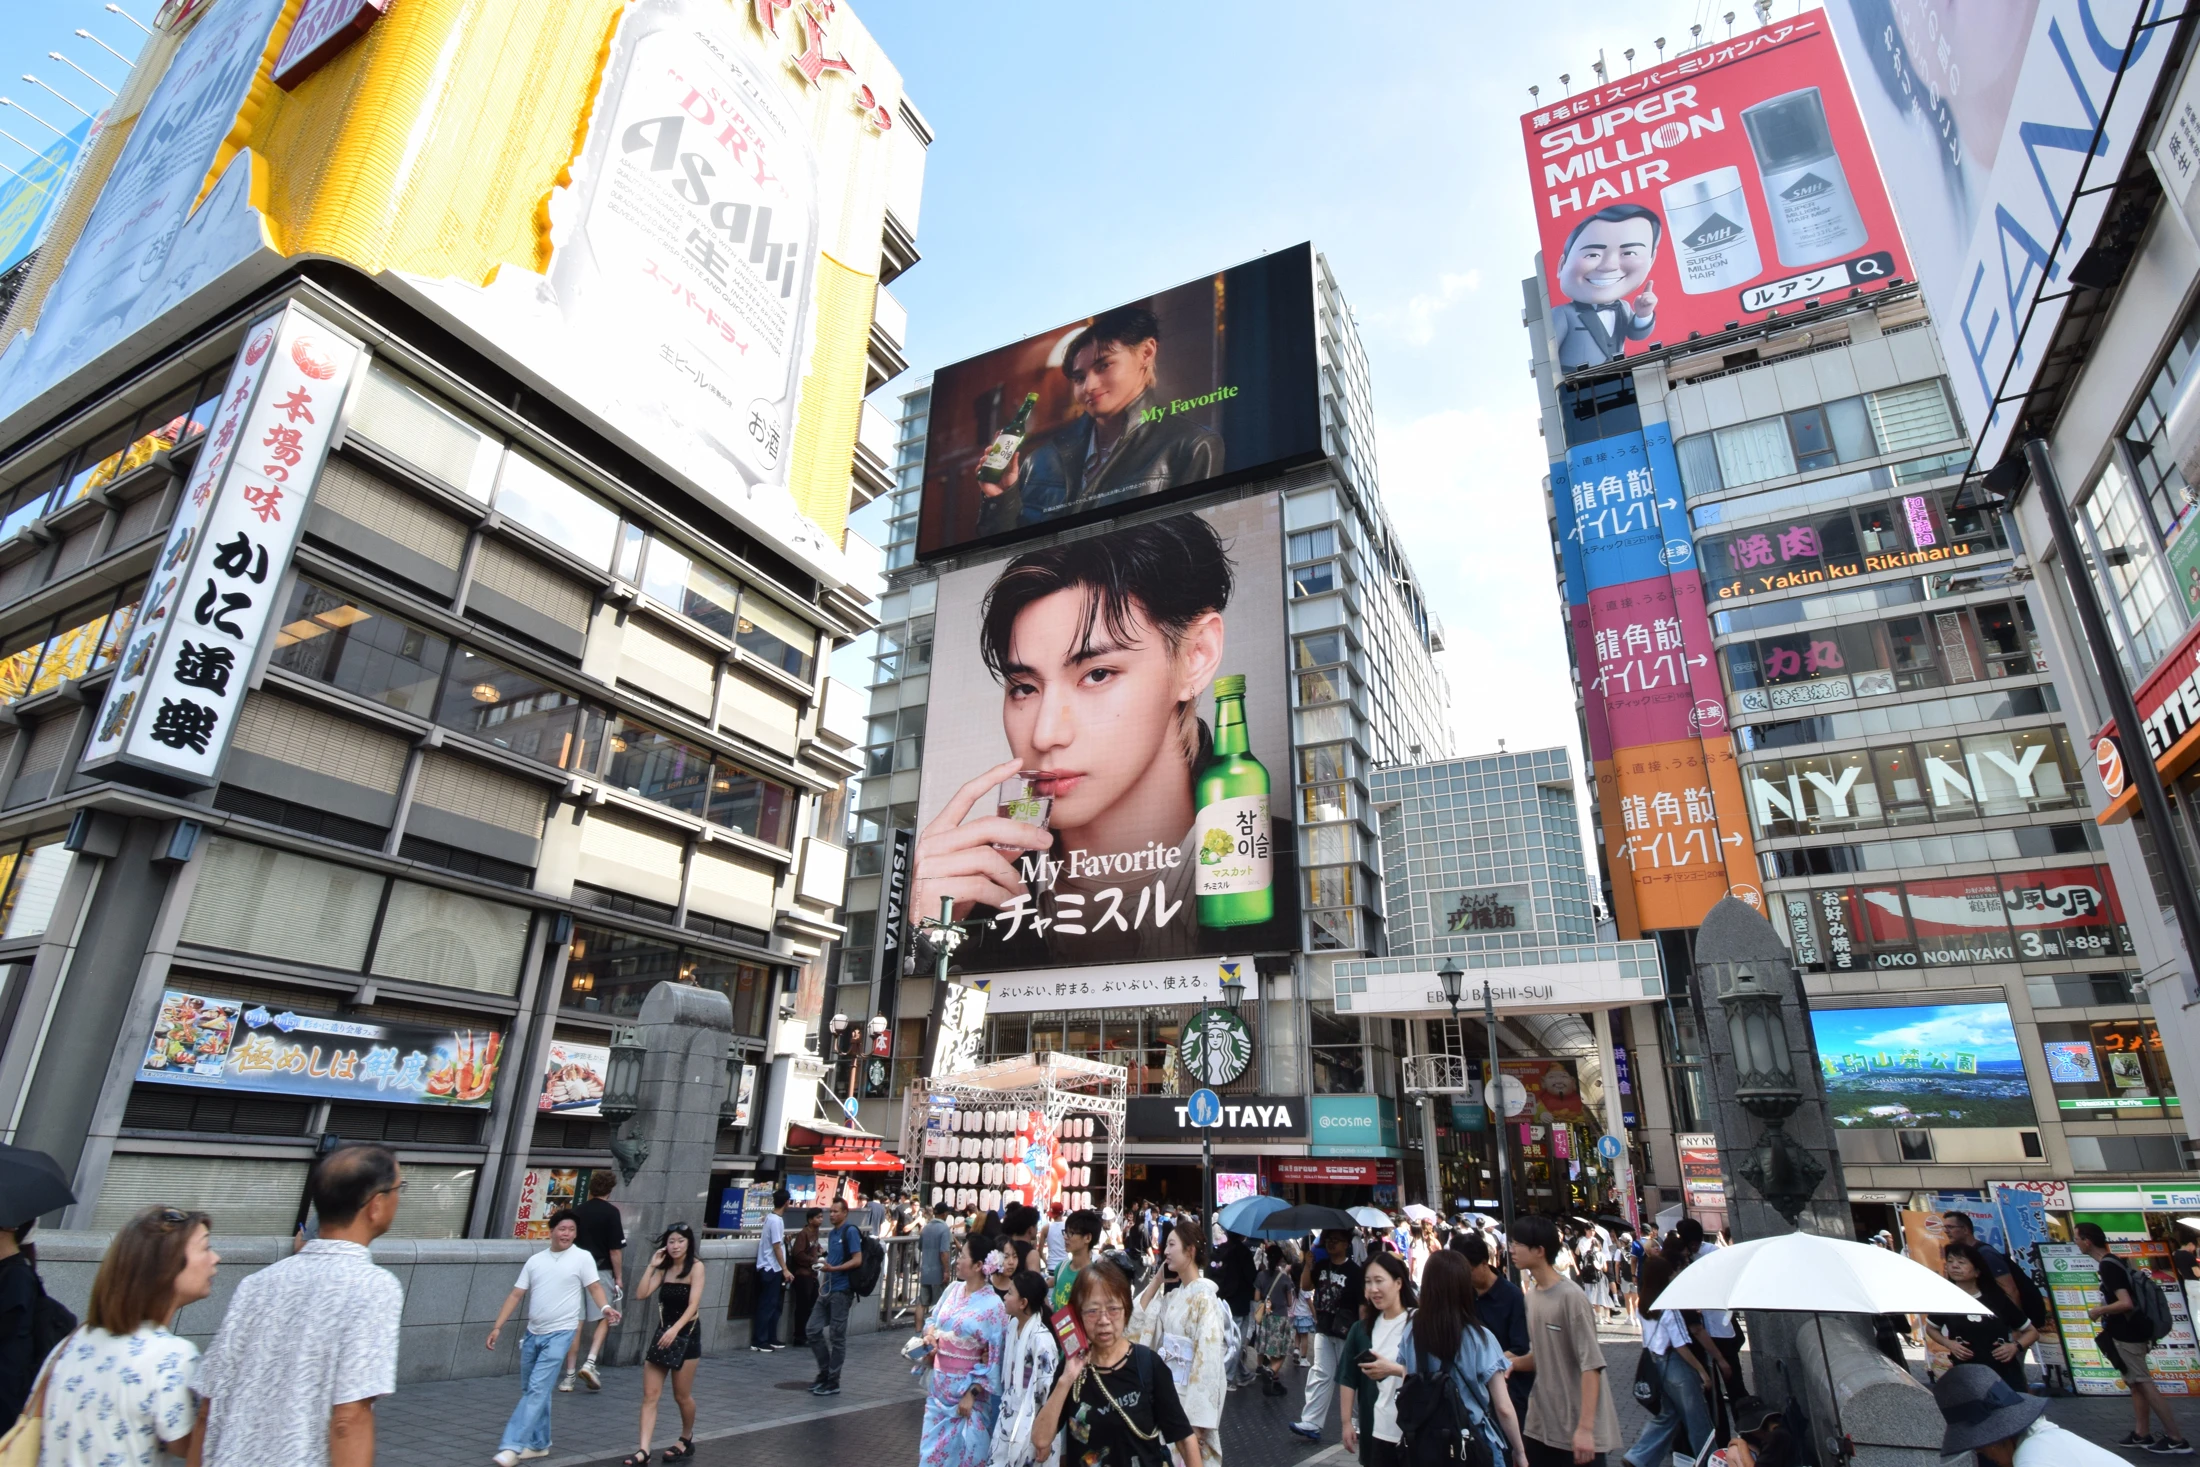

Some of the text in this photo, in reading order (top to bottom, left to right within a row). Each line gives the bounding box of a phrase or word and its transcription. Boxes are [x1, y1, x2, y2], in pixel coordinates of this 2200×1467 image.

[707, 87, 766, 154] SUPER
[1540, 84, 1700, 160] SUPER
[1543, 107, 1726, 188] MILLION
[1549, 159, 1671, 219] HAIR
[1792, 182, 1824, 198] SMH
[621, 115, 799, 299] Asahi
[1784, 202, 1816, 214] SUPER
[1786, 206, 1821, 219] MILLION
[1787, 214, 1809, 224] HAIR
[1696, 226, 1734, 247] SMH
[684, 228, 730, 288] 生
[1686, 252, 1724, 267] SUPER
[1687, 258, 1729, 274] MILLION
[1689, 269, 1716, 281] HAIR
[1753, 273, 1827, 308] ルアン
[641, 257, 749, 357] スーパードライ
[1138, 385, 1239, 425] My Favorite
[747, 410, 782, 462] お酒
[242, 384, 316, 524] 本場の味
[1572, 466, 1658, 514] 龍角散
[1567, 499, 1660, 545] ダイレクト
[1582, 540, 1624, 557] スティック
[1661, 542, 1690, 561] 生薬
[1729, 526, 1824, 571] 焼肉
[1865, 542, 1970, 573] Rikimaru
[1594, 616, 1686, 662] 龍角散
[1734, 663, 1756, 674] OPEN
[1766, 640, 1845, 679] 力丸
[1590, 654, 1690, 698] ダイレクト
[1606, 695, 1651, 711] スティック
[1772, 681, 1850, 706] 特選焼肉
[1692, 706, 1722, 723] 生薬
[1751, 744, 2047, 825] NY NY
[1621, 786, 1719, 832] 龍角散
[1616, 827, 1724, 872] ダイレクト
[1018, 841, 1182, 891] My Favorite
[1212, 865, 1254, 878] マスカット
[1634, 873, 1673, 887] トローチ
[884, 841, 908, 952] TSUTAYA
[1204, 880, 1231, 892] チャミスル
[1460, 893, 1499, 907] なんば
[1964, 885, 1998, 895] お好み焼き
[995, 880, 1183, 942] チャミスル
[1968, 900, 2002, 914] 鶴橋
[1788, 902, 1818, 965] 焼きそば
[1821, 890, 1853, 969] お好み焼き
[2020, 932, 2060, 958] 3階
[229, 1032, 429, 1092] 極めしは鮮度
[1613, 1046, 1632, 1095] 時計倉
[1173, 1105, 1293, 1128] TUTAYA
[1319, 1114, 1373, 1129] @cosme
[1522, 1144, 1542, 1155] 免税
[723, 1199, 740, 1209] Asahi
[815, 1181, 830, 1206] かに
[2158, 1358, 2179, 1366] FOREST
